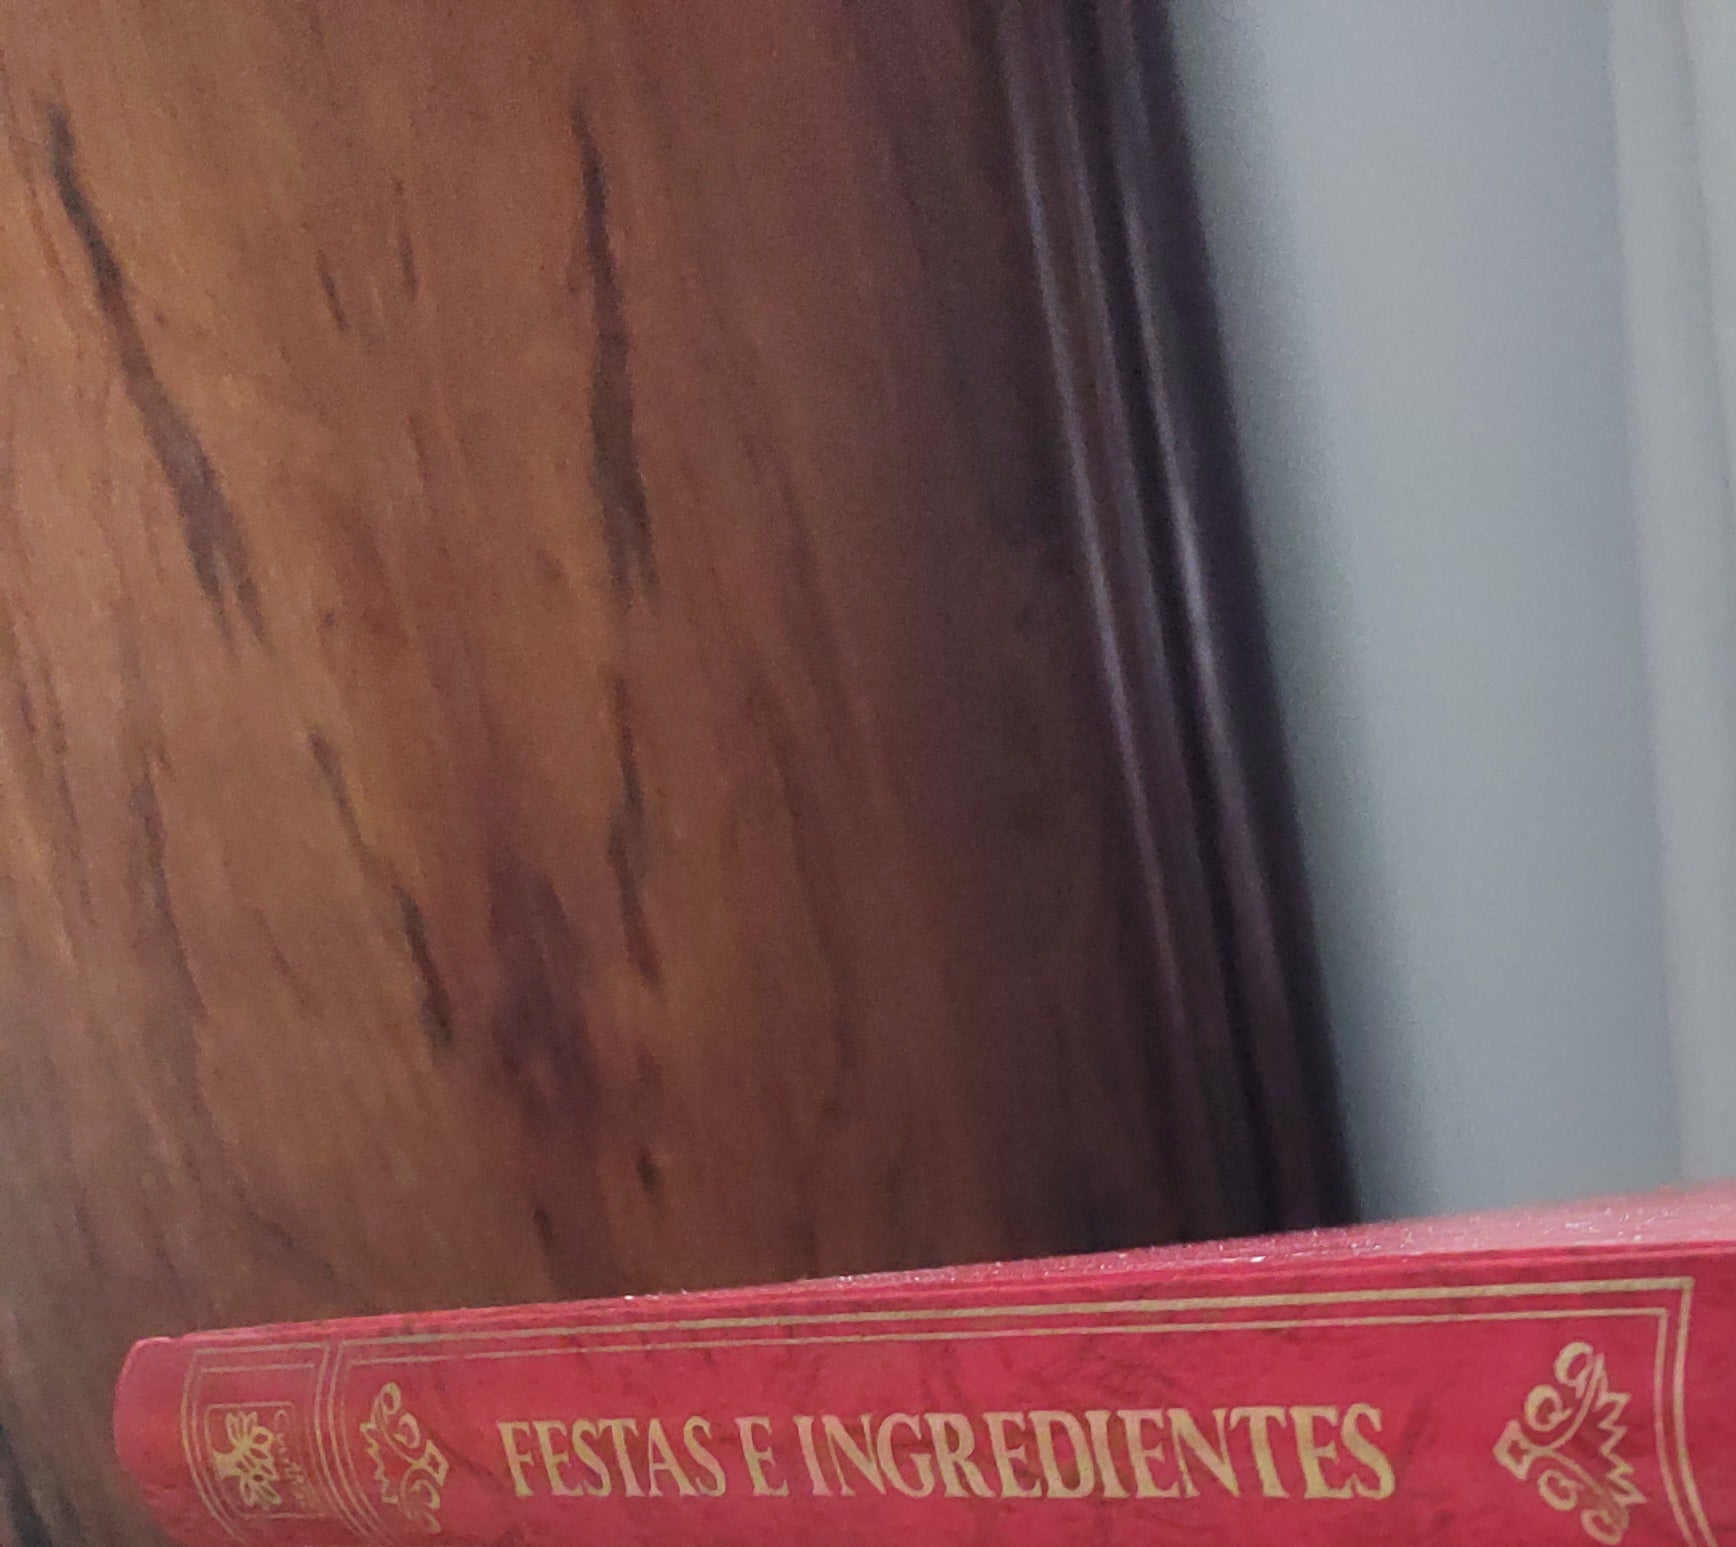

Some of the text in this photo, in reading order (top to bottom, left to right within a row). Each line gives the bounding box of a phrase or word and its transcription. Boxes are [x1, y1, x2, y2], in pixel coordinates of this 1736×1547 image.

[496, 1402, 1397, 1502] FESTAS E INGREDIENTES
